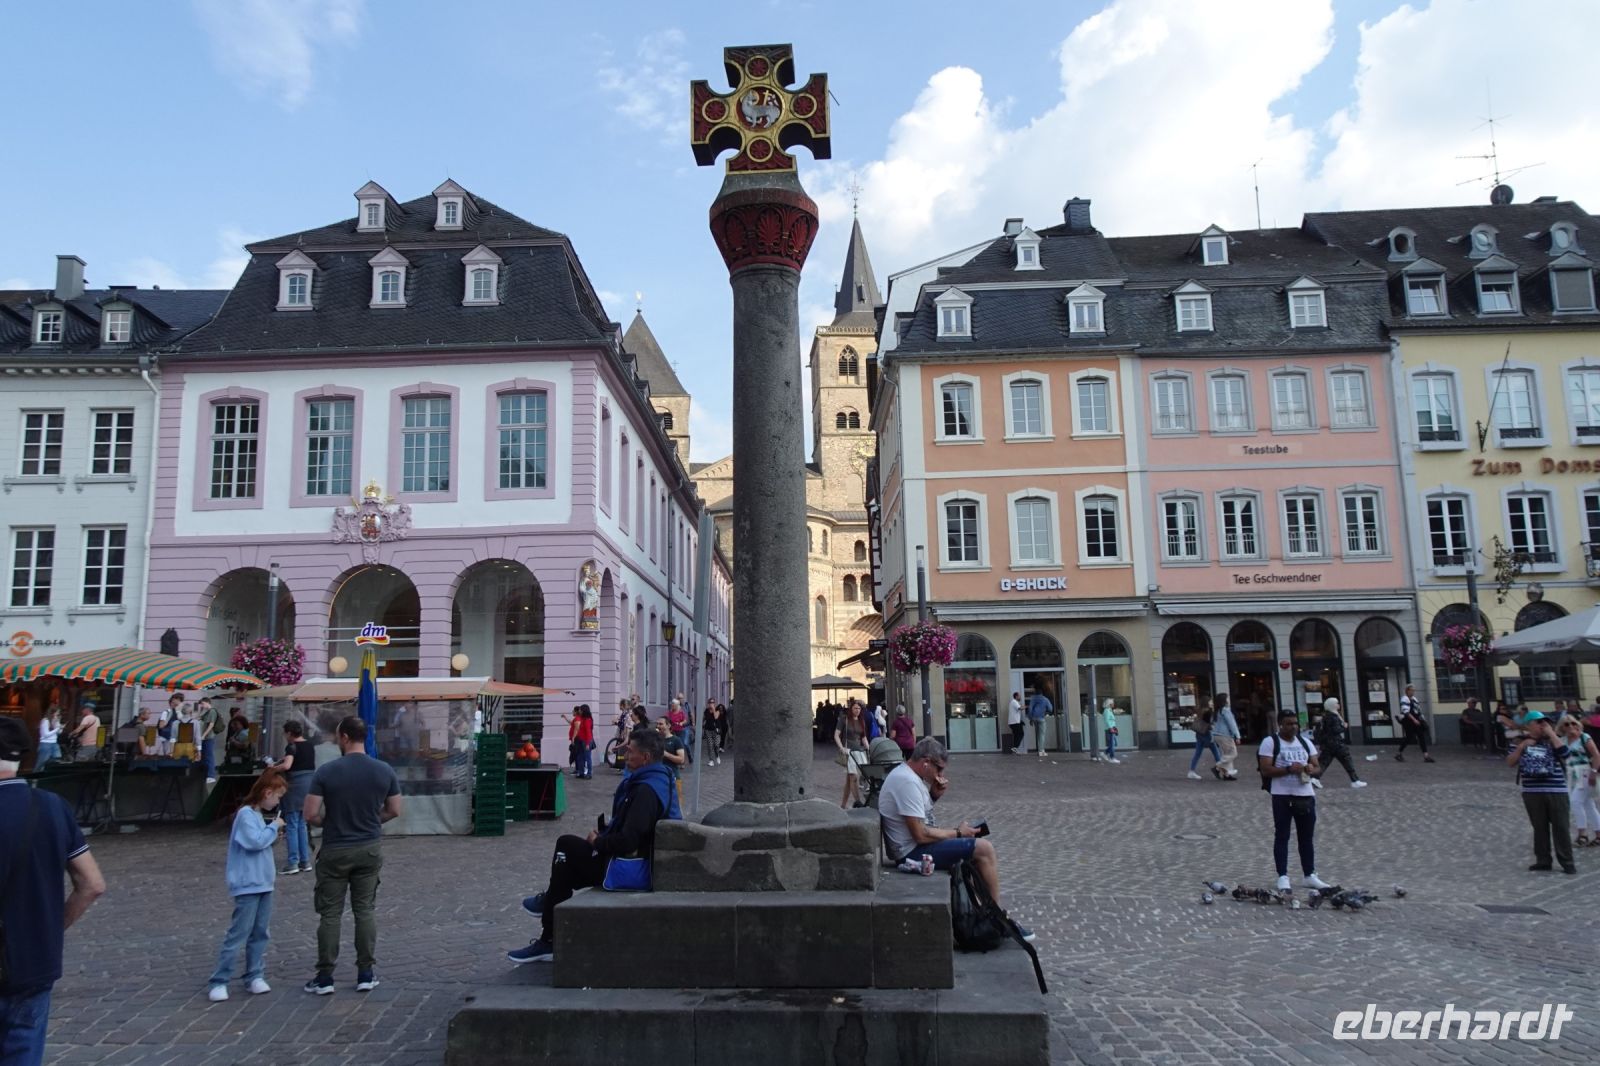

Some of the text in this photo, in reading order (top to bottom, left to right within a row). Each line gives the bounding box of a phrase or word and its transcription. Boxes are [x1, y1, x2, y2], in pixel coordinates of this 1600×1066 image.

[1242, 444, 1289, 455] Teestube
[1471, 458, 1522, 476] Zum
[1001, 576, 1067, 591] G-SHOCK
[1232, 571, 1322, 584] Tee Gschwendner
[362, 622, 386, 637] dm
[33, 639, 66, 647] more
